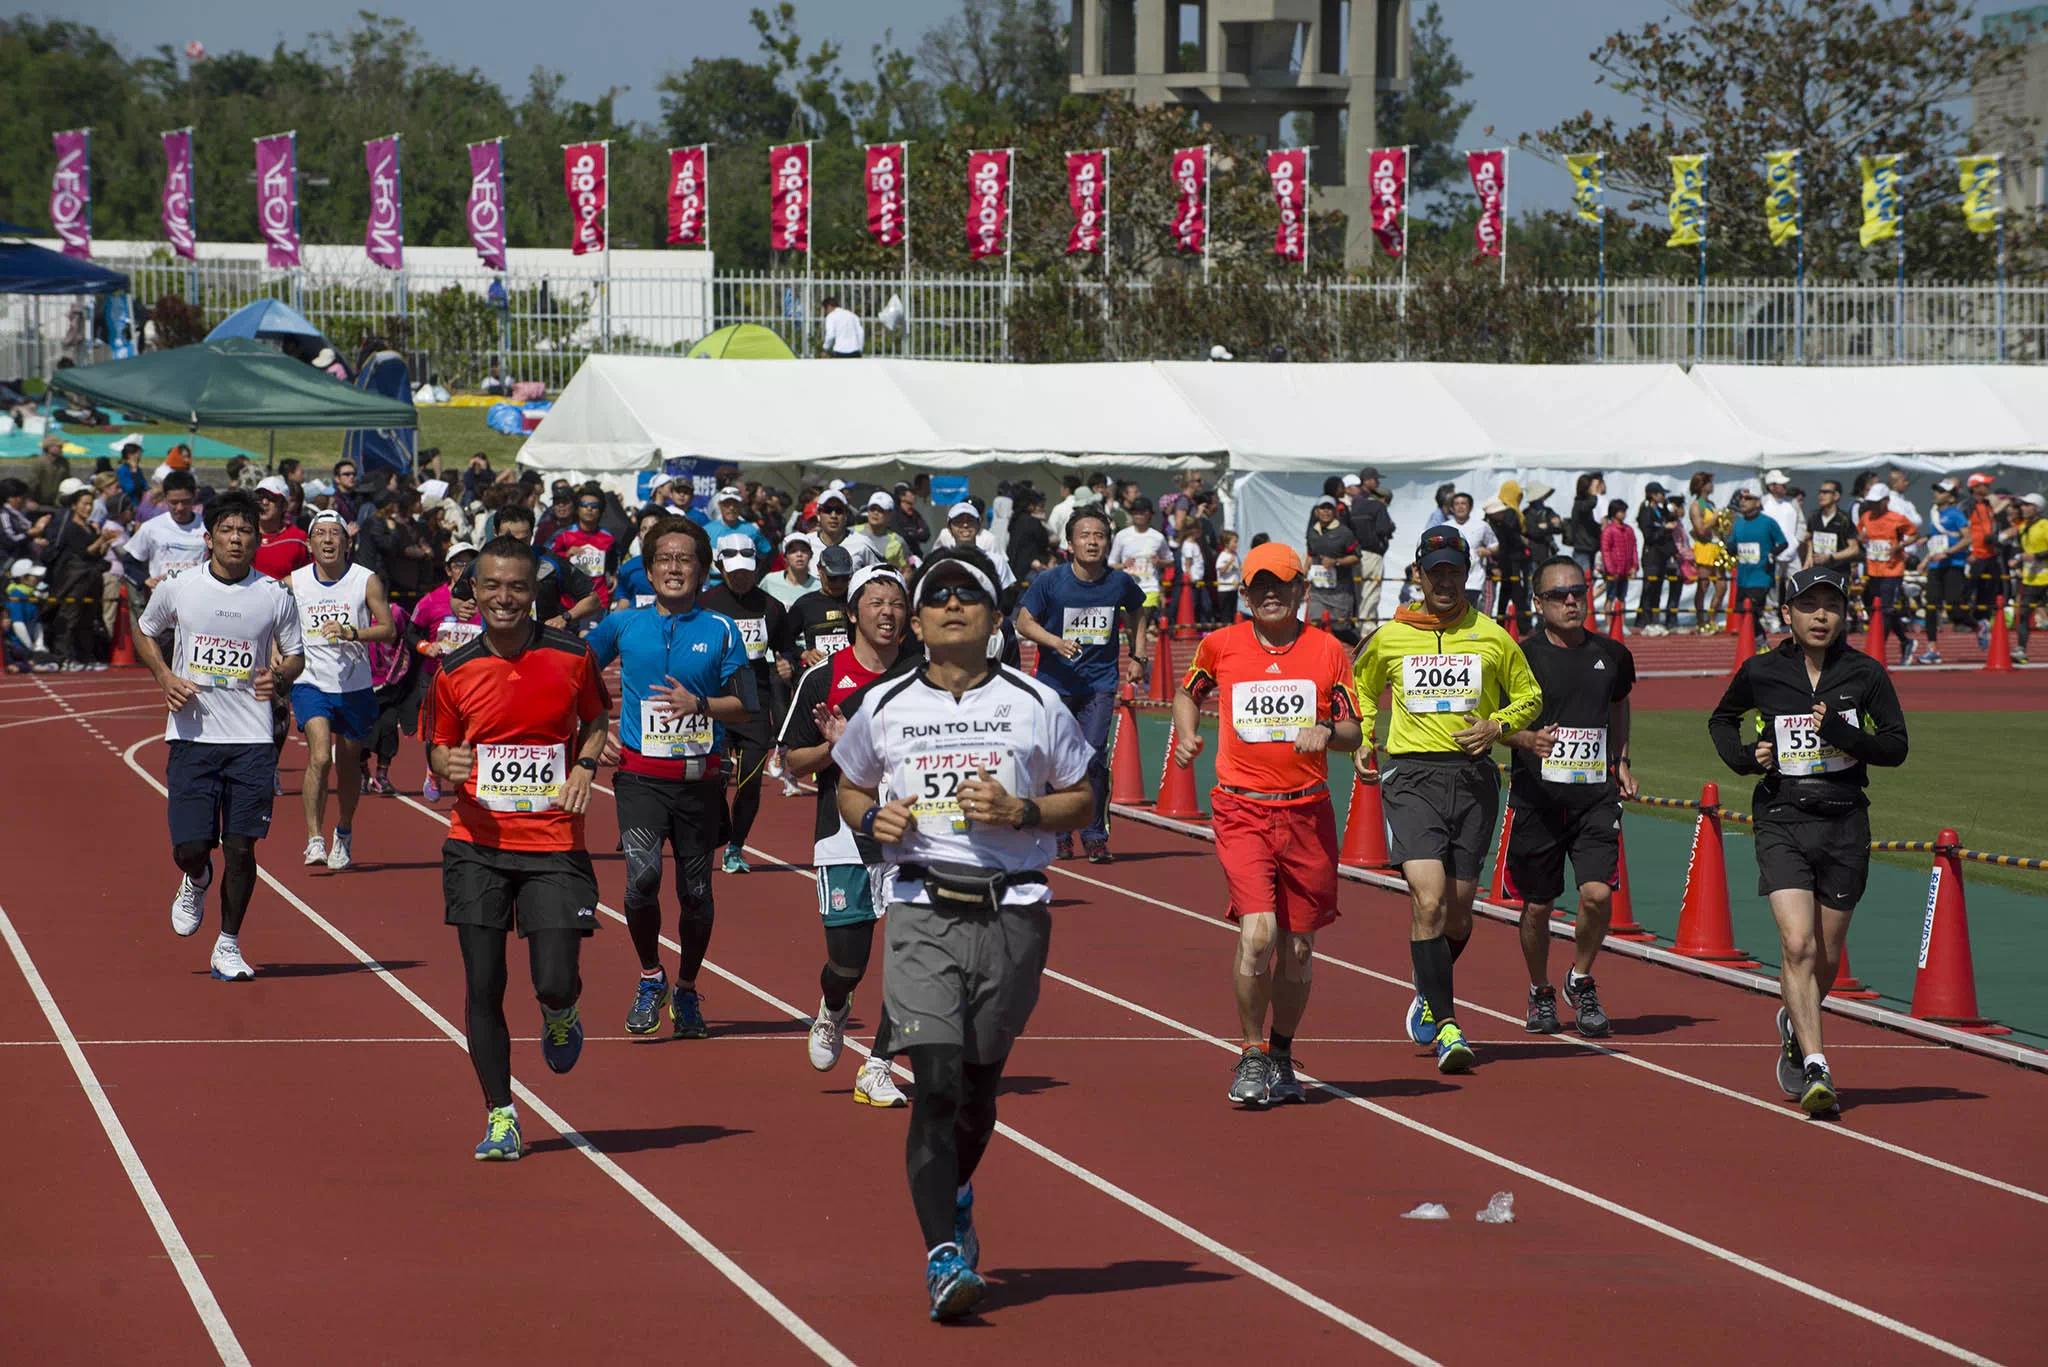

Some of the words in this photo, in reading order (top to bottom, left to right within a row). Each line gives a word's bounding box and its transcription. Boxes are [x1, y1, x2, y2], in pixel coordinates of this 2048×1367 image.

[307, 603, 351, 613] オリオンビール
[1071, 616, 1107, 628] 4413
[195, 635, 250, 650] オリオンビール
[194, 645, 253, 668] 14320
[1411, 655, 1472, 667] オリオンビール
[1415, 668, 1470, 687] 2064
[1250, 684, 1298, 693] docomo
[1245, 694, 1304, 715] 4869
[902, 724, 941, 739] RUN
[944, 722, 968, 734] TO
[973, 721, 1012, 733] LIVE
[1552, 728, 1602, 740] オリオンビール
[487, 745, 557, 760] オリオンビール
[1553, 741, 1600, 759] 3739
[915, 751, 1002, 771] オリオンビール
[491, 761, 554, 783] 6946
[480, 784, 556, 793] おきなわマラソン
[923, 770, 998, 799] 52
[1919, 873, 1940, 963] おきなわマラソン
